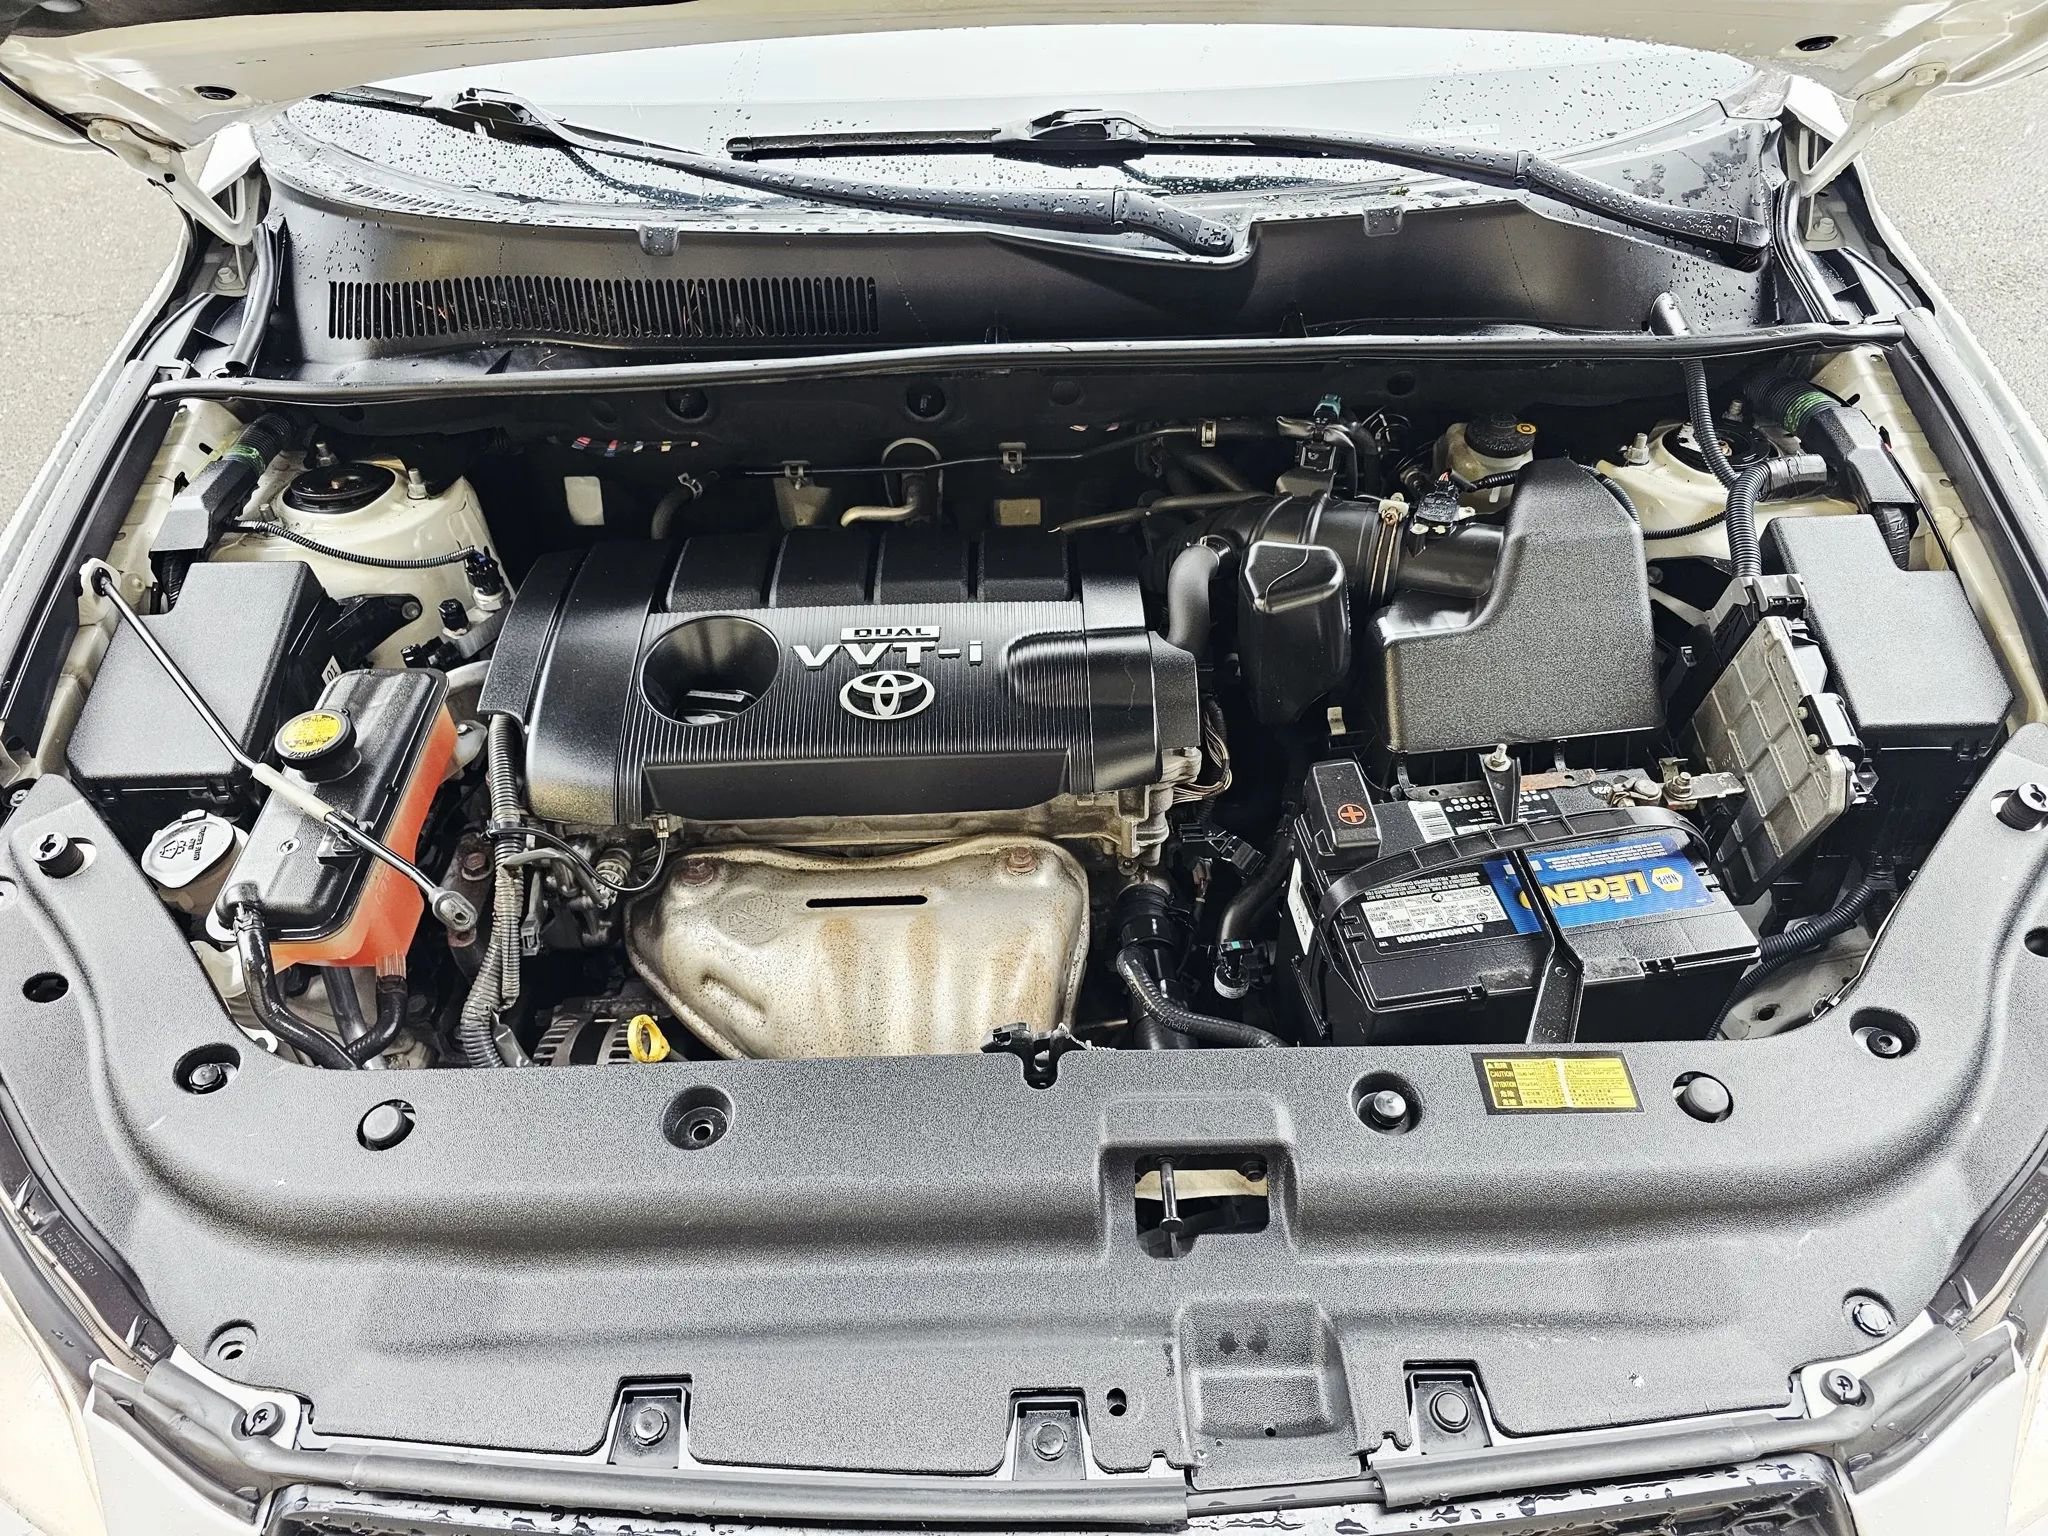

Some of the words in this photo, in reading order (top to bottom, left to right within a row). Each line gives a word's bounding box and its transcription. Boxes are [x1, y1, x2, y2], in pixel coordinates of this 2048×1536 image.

[854, 627, 931, 638] DUAL
[791, 640, 983, 669] VVT-i
[1655, 872, 1679, 885] NAPA
[1490, 1070, 1514, 1078] CAUTION
